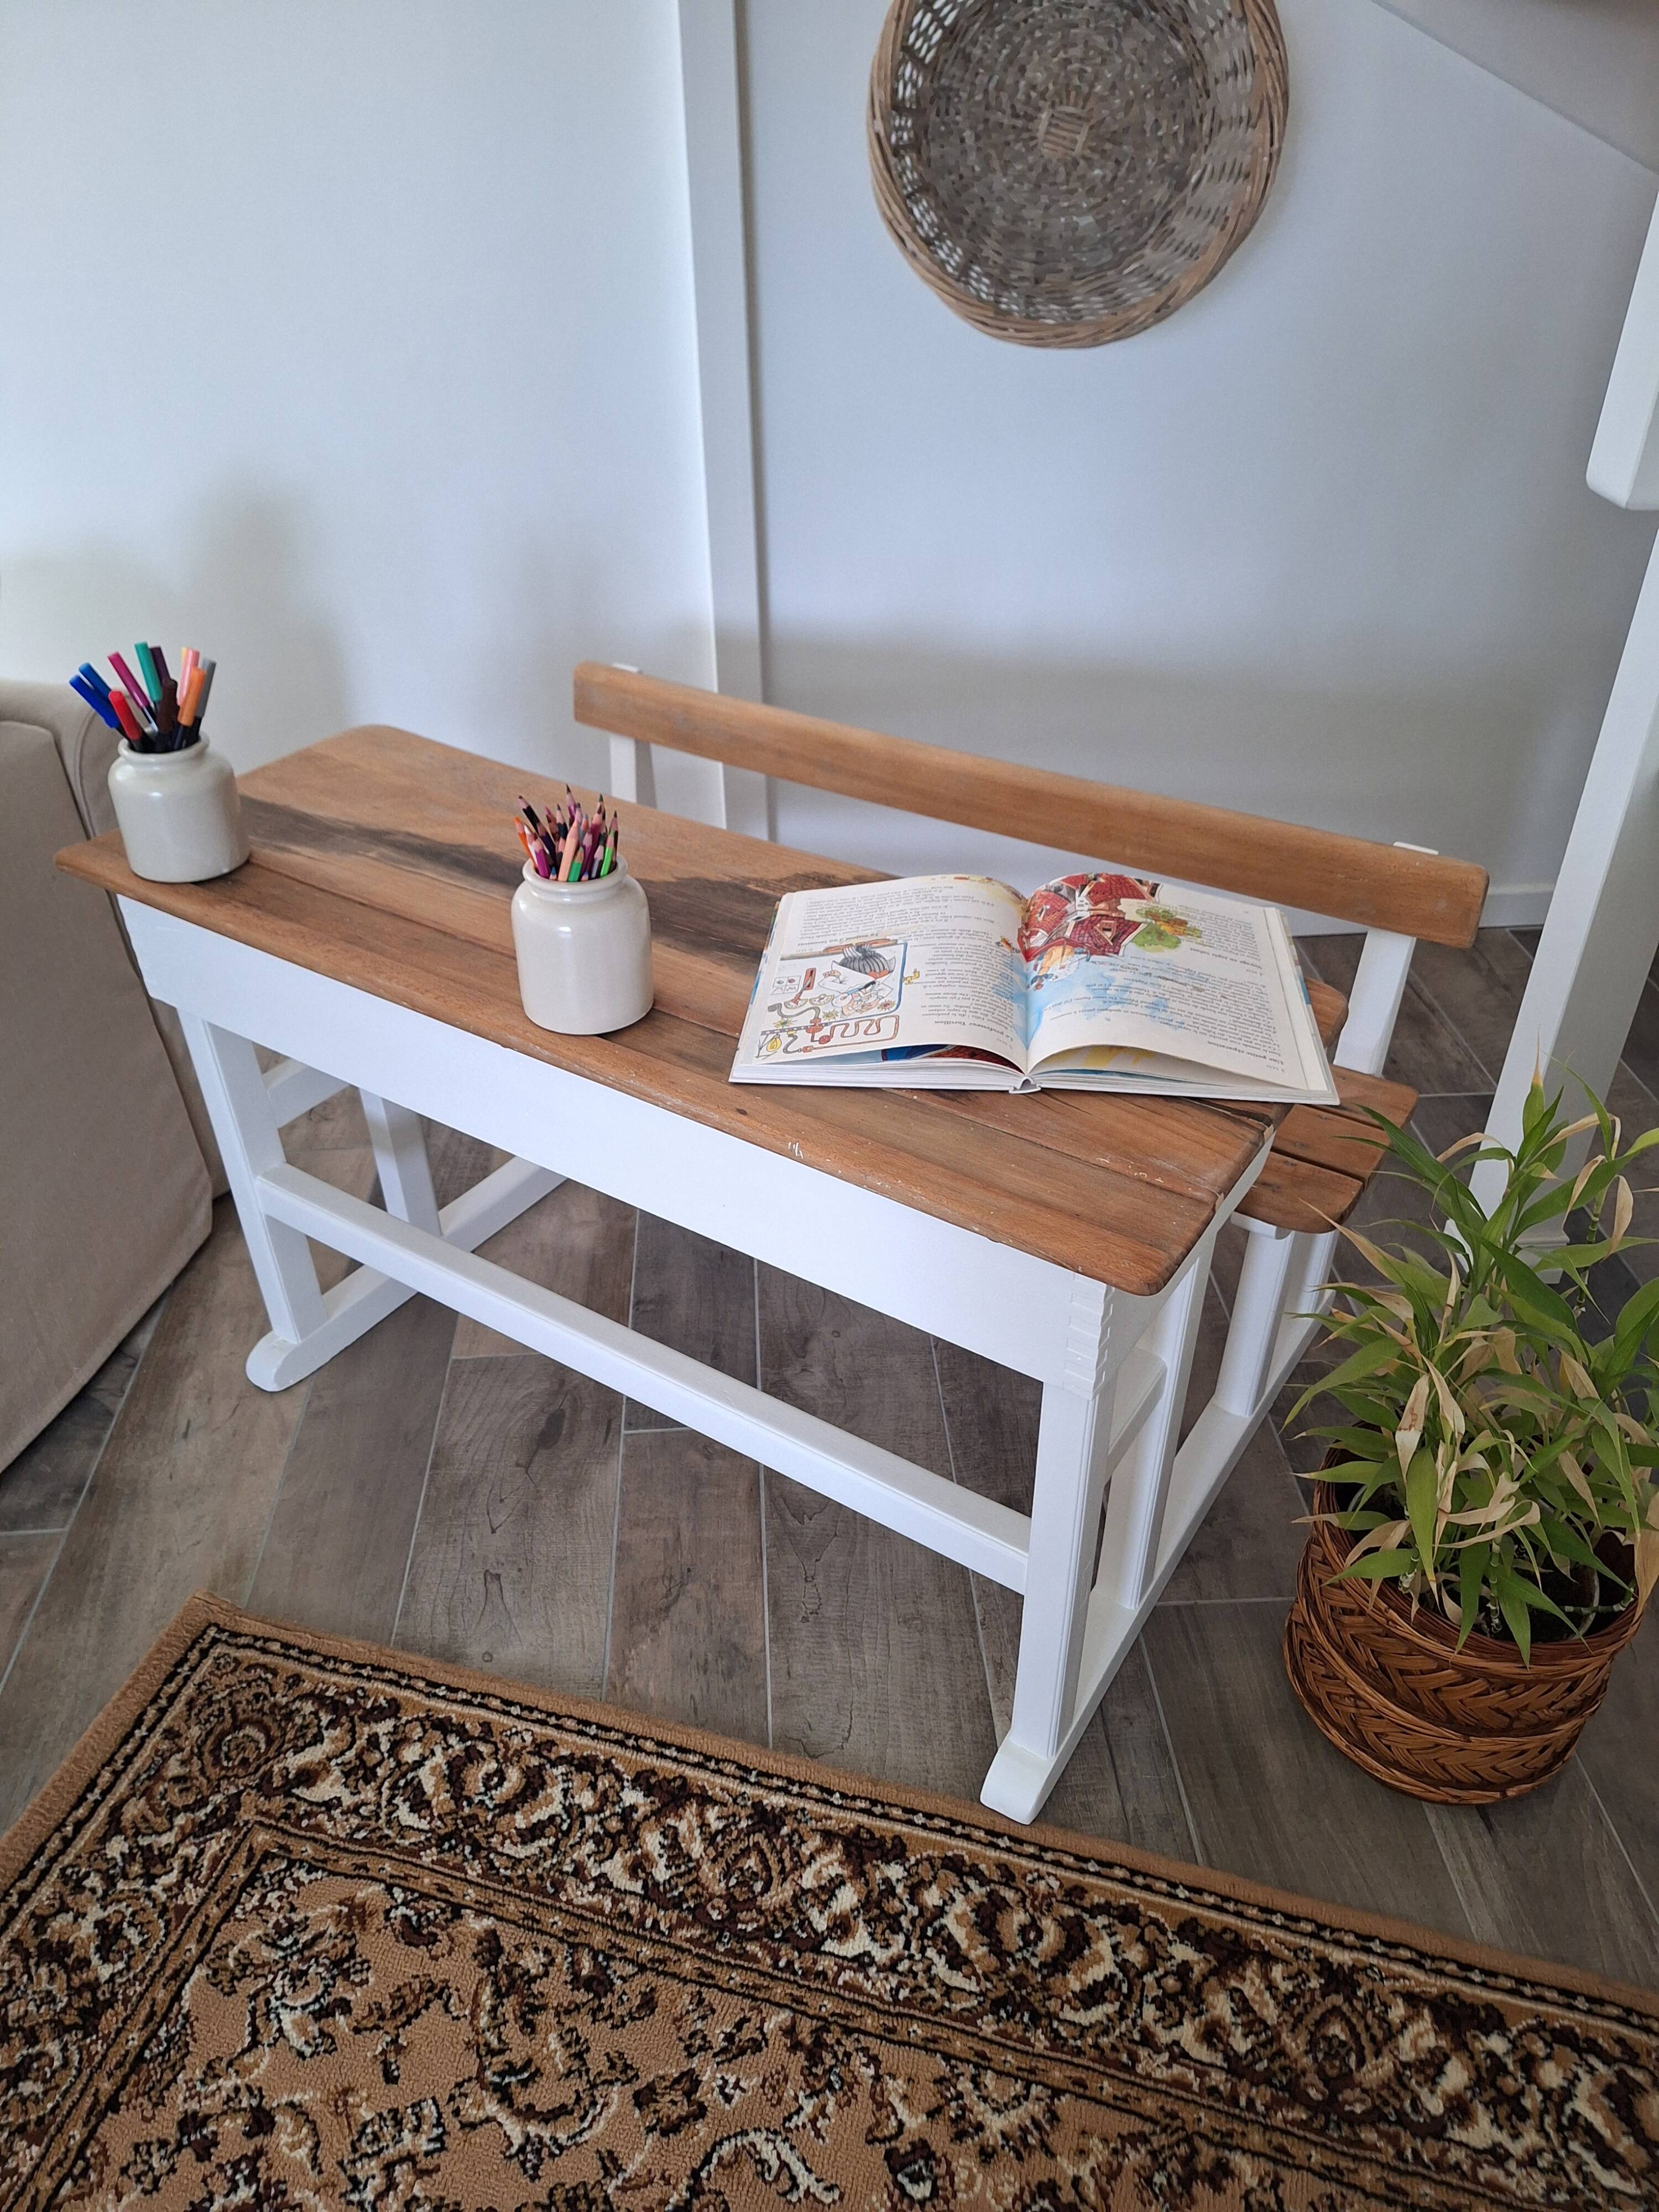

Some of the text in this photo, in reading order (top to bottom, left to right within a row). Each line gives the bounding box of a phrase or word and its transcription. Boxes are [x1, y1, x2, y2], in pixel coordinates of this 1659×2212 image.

[1190, 947, 1210, 956] volant
[1239, 961, 1262, 969] Voyage
[969, 1022, 1004, 1036] professeur
[1208, 1041, 1244, 1053] réparation
